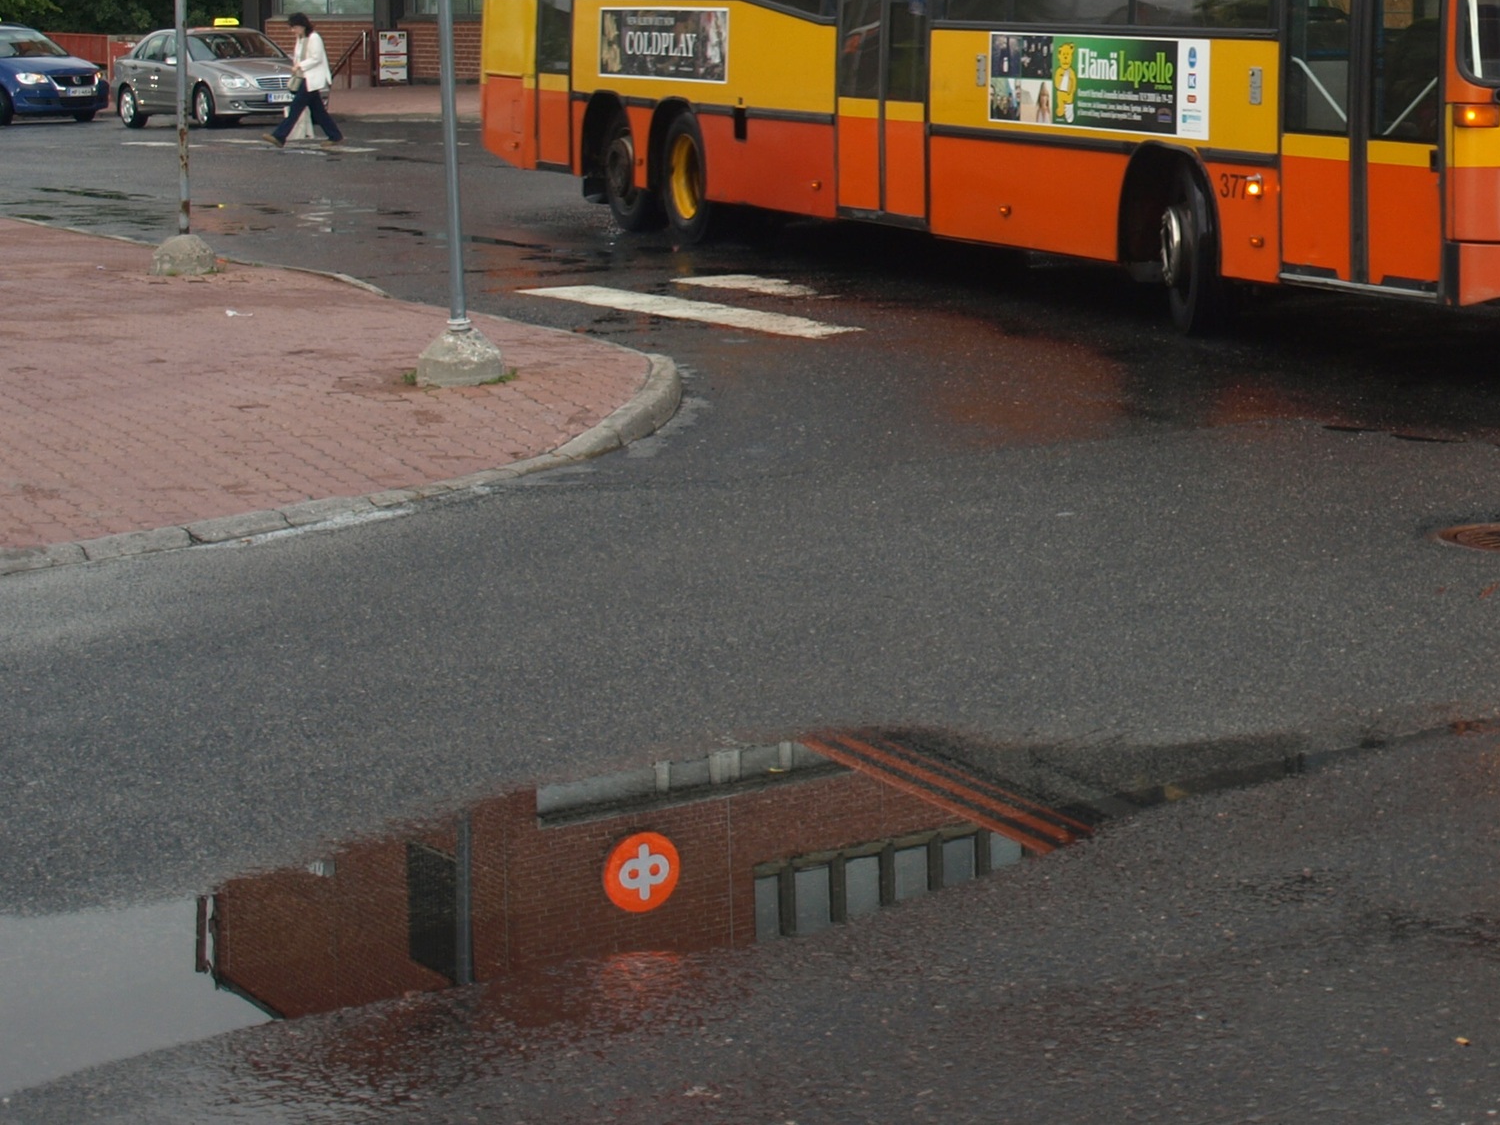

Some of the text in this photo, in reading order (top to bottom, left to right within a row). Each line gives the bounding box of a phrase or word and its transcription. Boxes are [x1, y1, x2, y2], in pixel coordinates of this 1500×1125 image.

[625, 31, 697, 57] COLDPLAY
[1078, 48, 1173, 88] Elämä Lapselle
